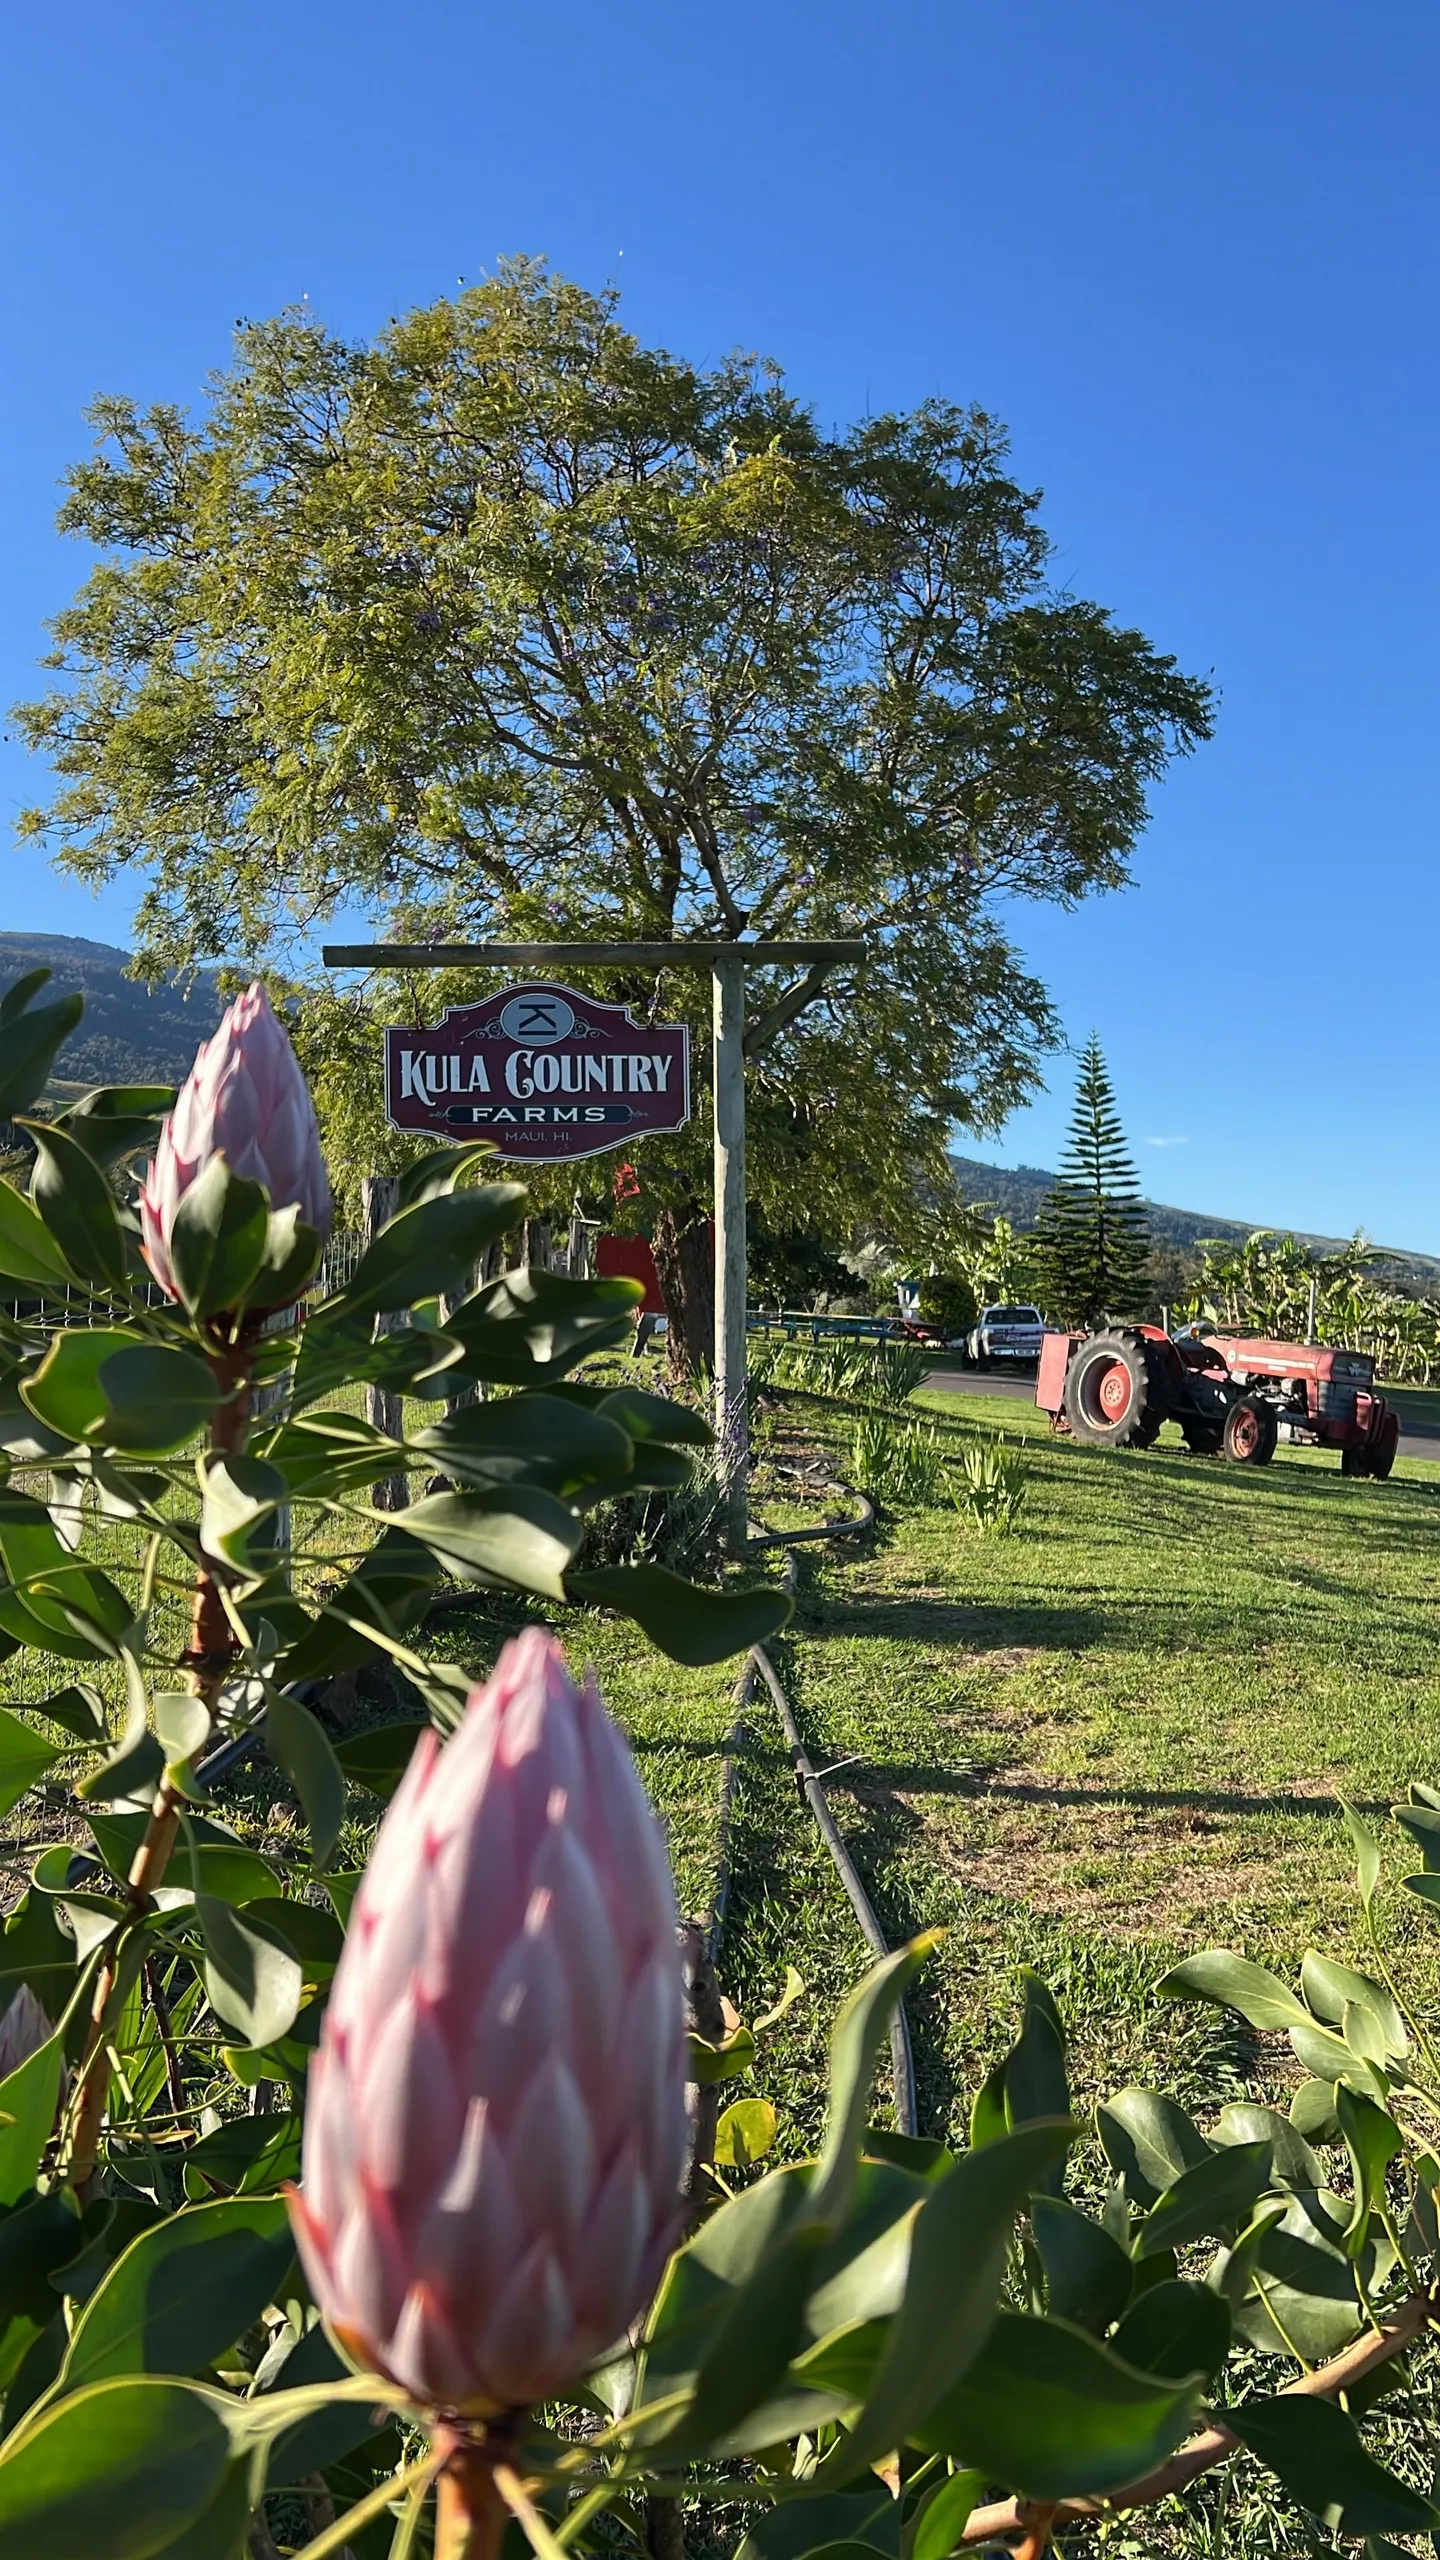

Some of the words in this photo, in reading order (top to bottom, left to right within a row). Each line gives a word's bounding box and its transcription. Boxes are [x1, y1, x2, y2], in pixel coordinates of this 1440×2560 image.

[400, 1050, 491, 1106] KULA
[504, 1050, 673, 1099] COUNTRY
[472, 1107, 606, 1122] FARMS
